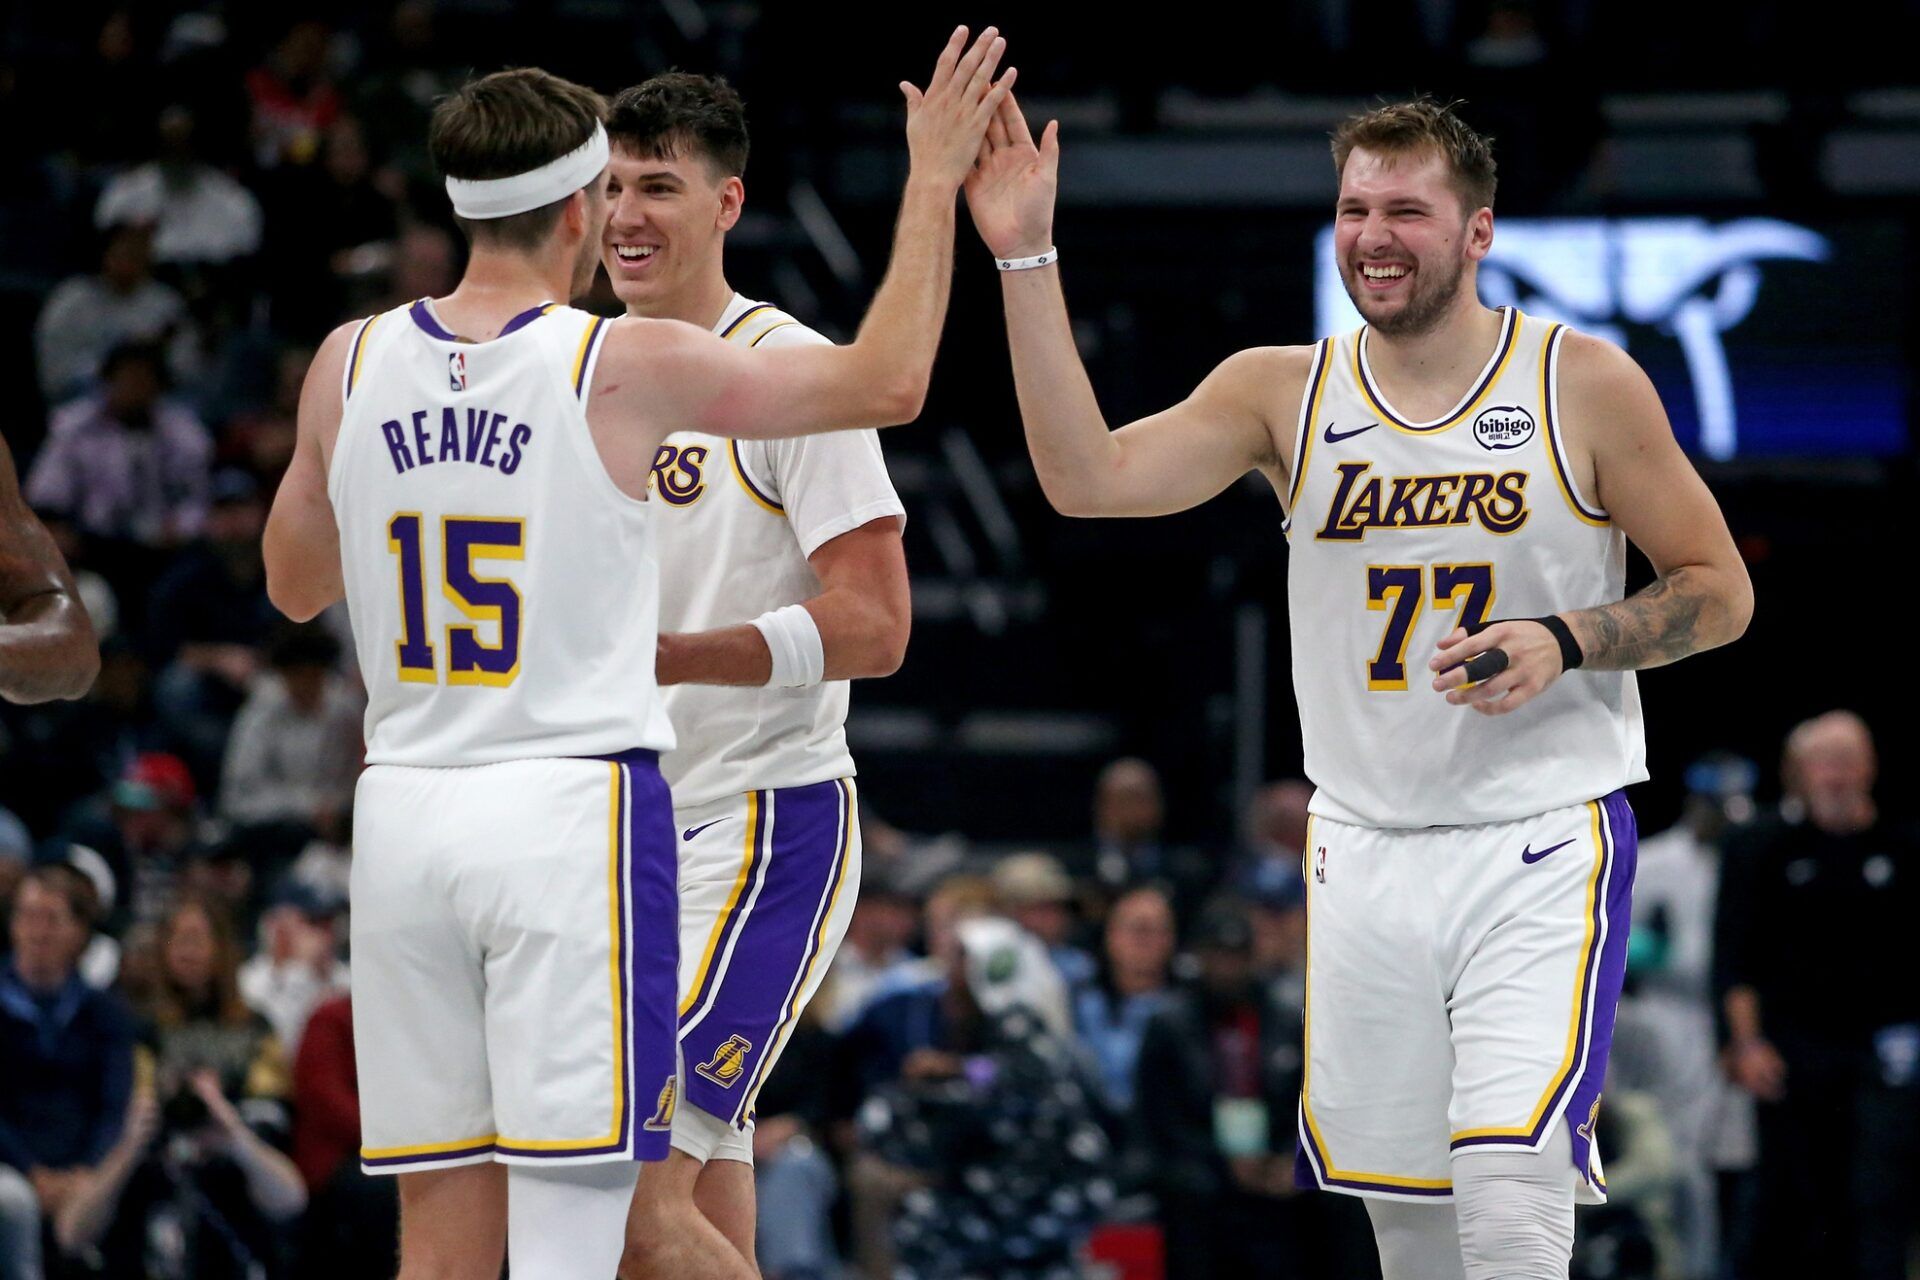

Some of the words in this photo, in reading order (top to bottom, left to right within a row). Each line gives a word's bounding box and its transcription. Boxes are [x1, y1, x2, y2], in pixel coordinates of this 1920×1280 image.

[381, 407, 532, 475] REAVES
[1479, 417, 1531, 436] bibigo
[1314, 461, 1531, 542] LAKERS
[386, 511, 526, 688] 15
[1366, 561, 1496, 691] 77
